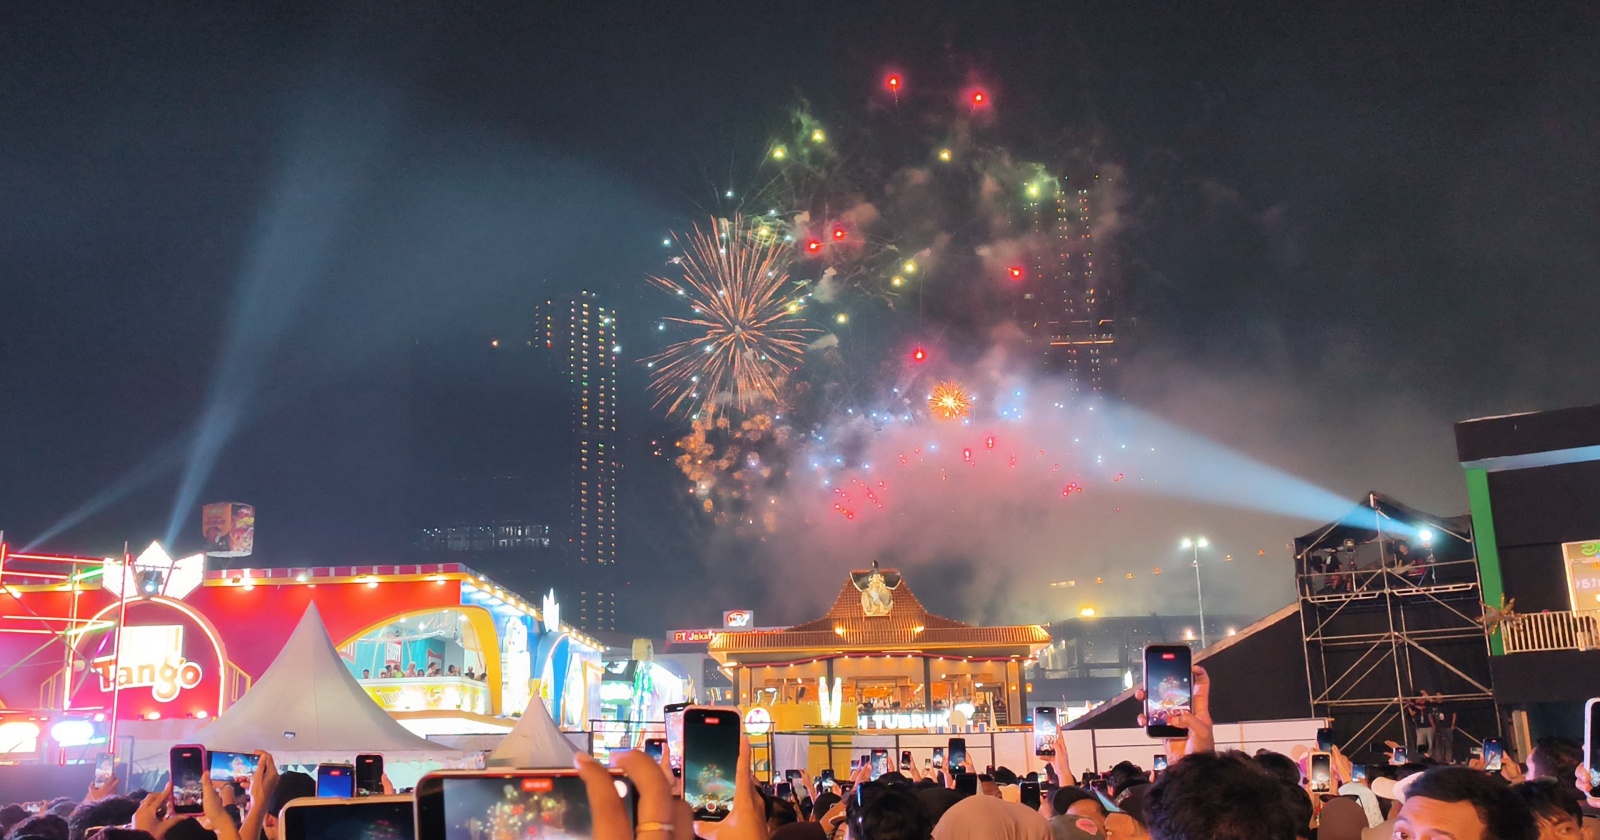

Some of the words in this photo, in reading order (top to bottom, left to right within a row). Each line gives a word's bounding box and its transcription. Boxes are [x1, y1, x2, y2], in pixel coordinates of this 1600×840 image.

[674, 632, 687, 642] PT
[91, 656, 202, 701] Tango
[872, 712, 950, 729] TUBRUK
